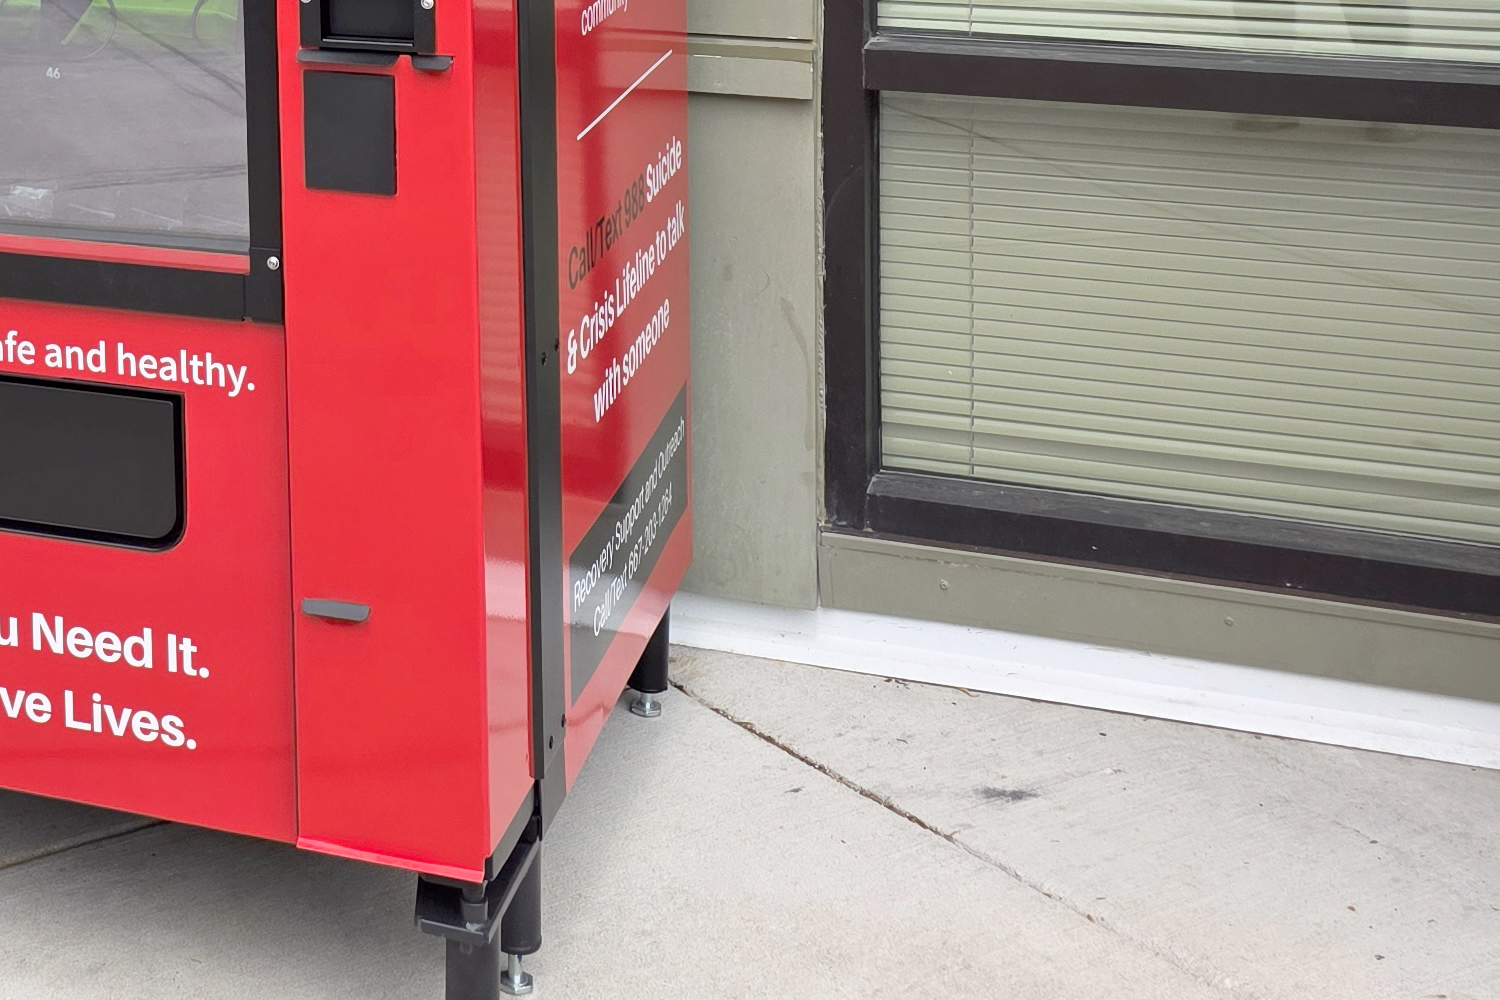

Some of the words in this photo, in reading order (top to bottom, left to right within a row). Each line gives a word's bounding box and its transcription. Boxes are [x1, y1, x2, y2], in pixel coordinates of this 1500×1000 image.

[46, 67, 61, 79] 46
[568, 202, 624, 290] Call/Text
[624, 173, 645, 229] 988
[646, 135, 682, 203] Suicide
[567, 328, 578, 375] &
[580, 290, 615, 360] Crisis
[616, 242, 655, 318] Lifeline
[656, 229, 667, 266] to
[667, 200, 685, 251] talk
[44, 340, 107, 373] and
[117, 342, 255, 397] healthy.
[593, 357, 621, 423] with
[622, 298, 670, 386] someone
[574, 536, 615, 613] Recovery
[615, 485, 645, 551] Support
[645, 459, 657, 503] and
[658, 416, 685, 479] Outreach
[593, 562, 627, 636] Call/Text
[628, 481, 672, 580] 667-203-1264
[32, 612, 153, 669] Need
[167, 633, 210, 679] It.
[64, 689, 197, 750] Lives.
